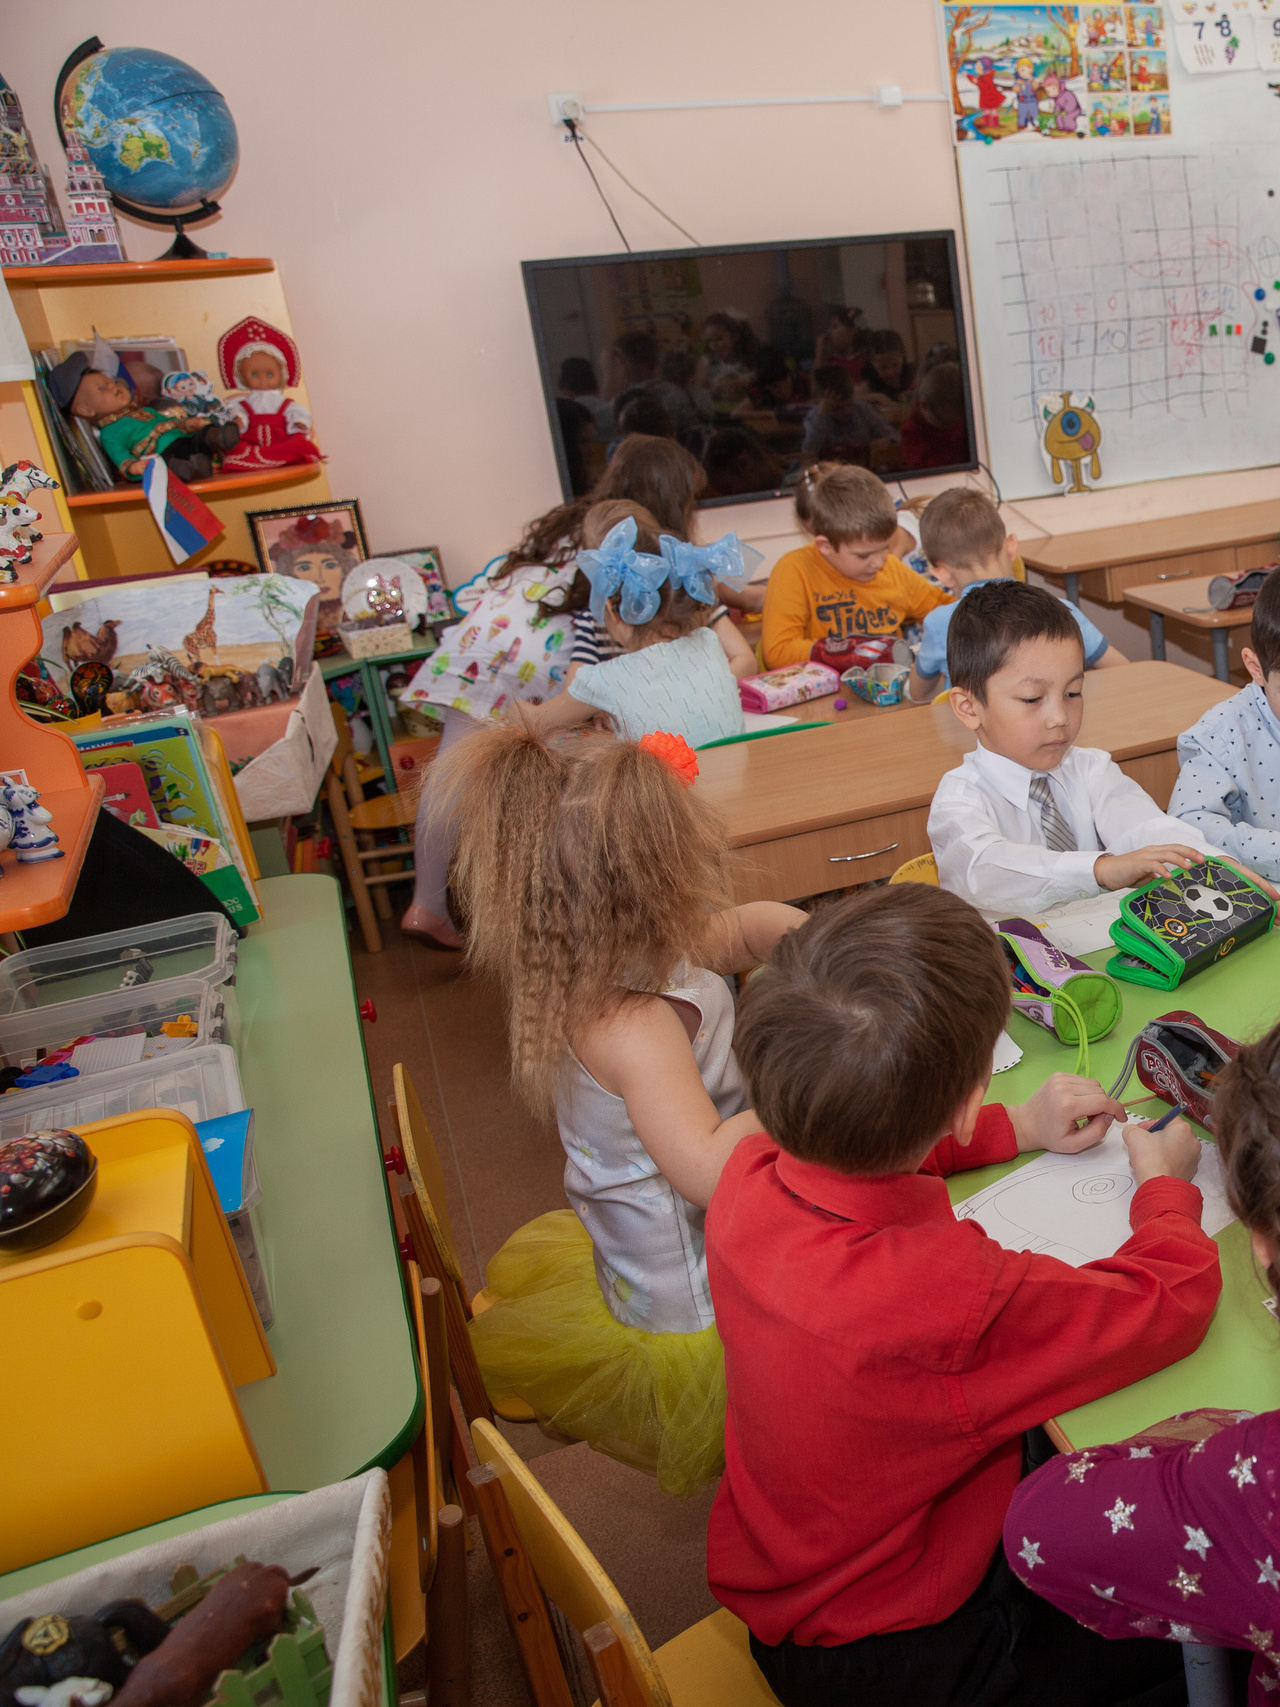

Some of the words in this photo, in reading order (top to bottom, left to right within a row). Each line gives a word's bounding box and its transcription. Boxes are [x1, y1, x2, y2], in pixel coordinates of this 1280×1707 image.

[1193, 21, 1205, 40] 7
[1220, 19, 1232, 37] 8
[816, 601, 898, 639] Tigers
